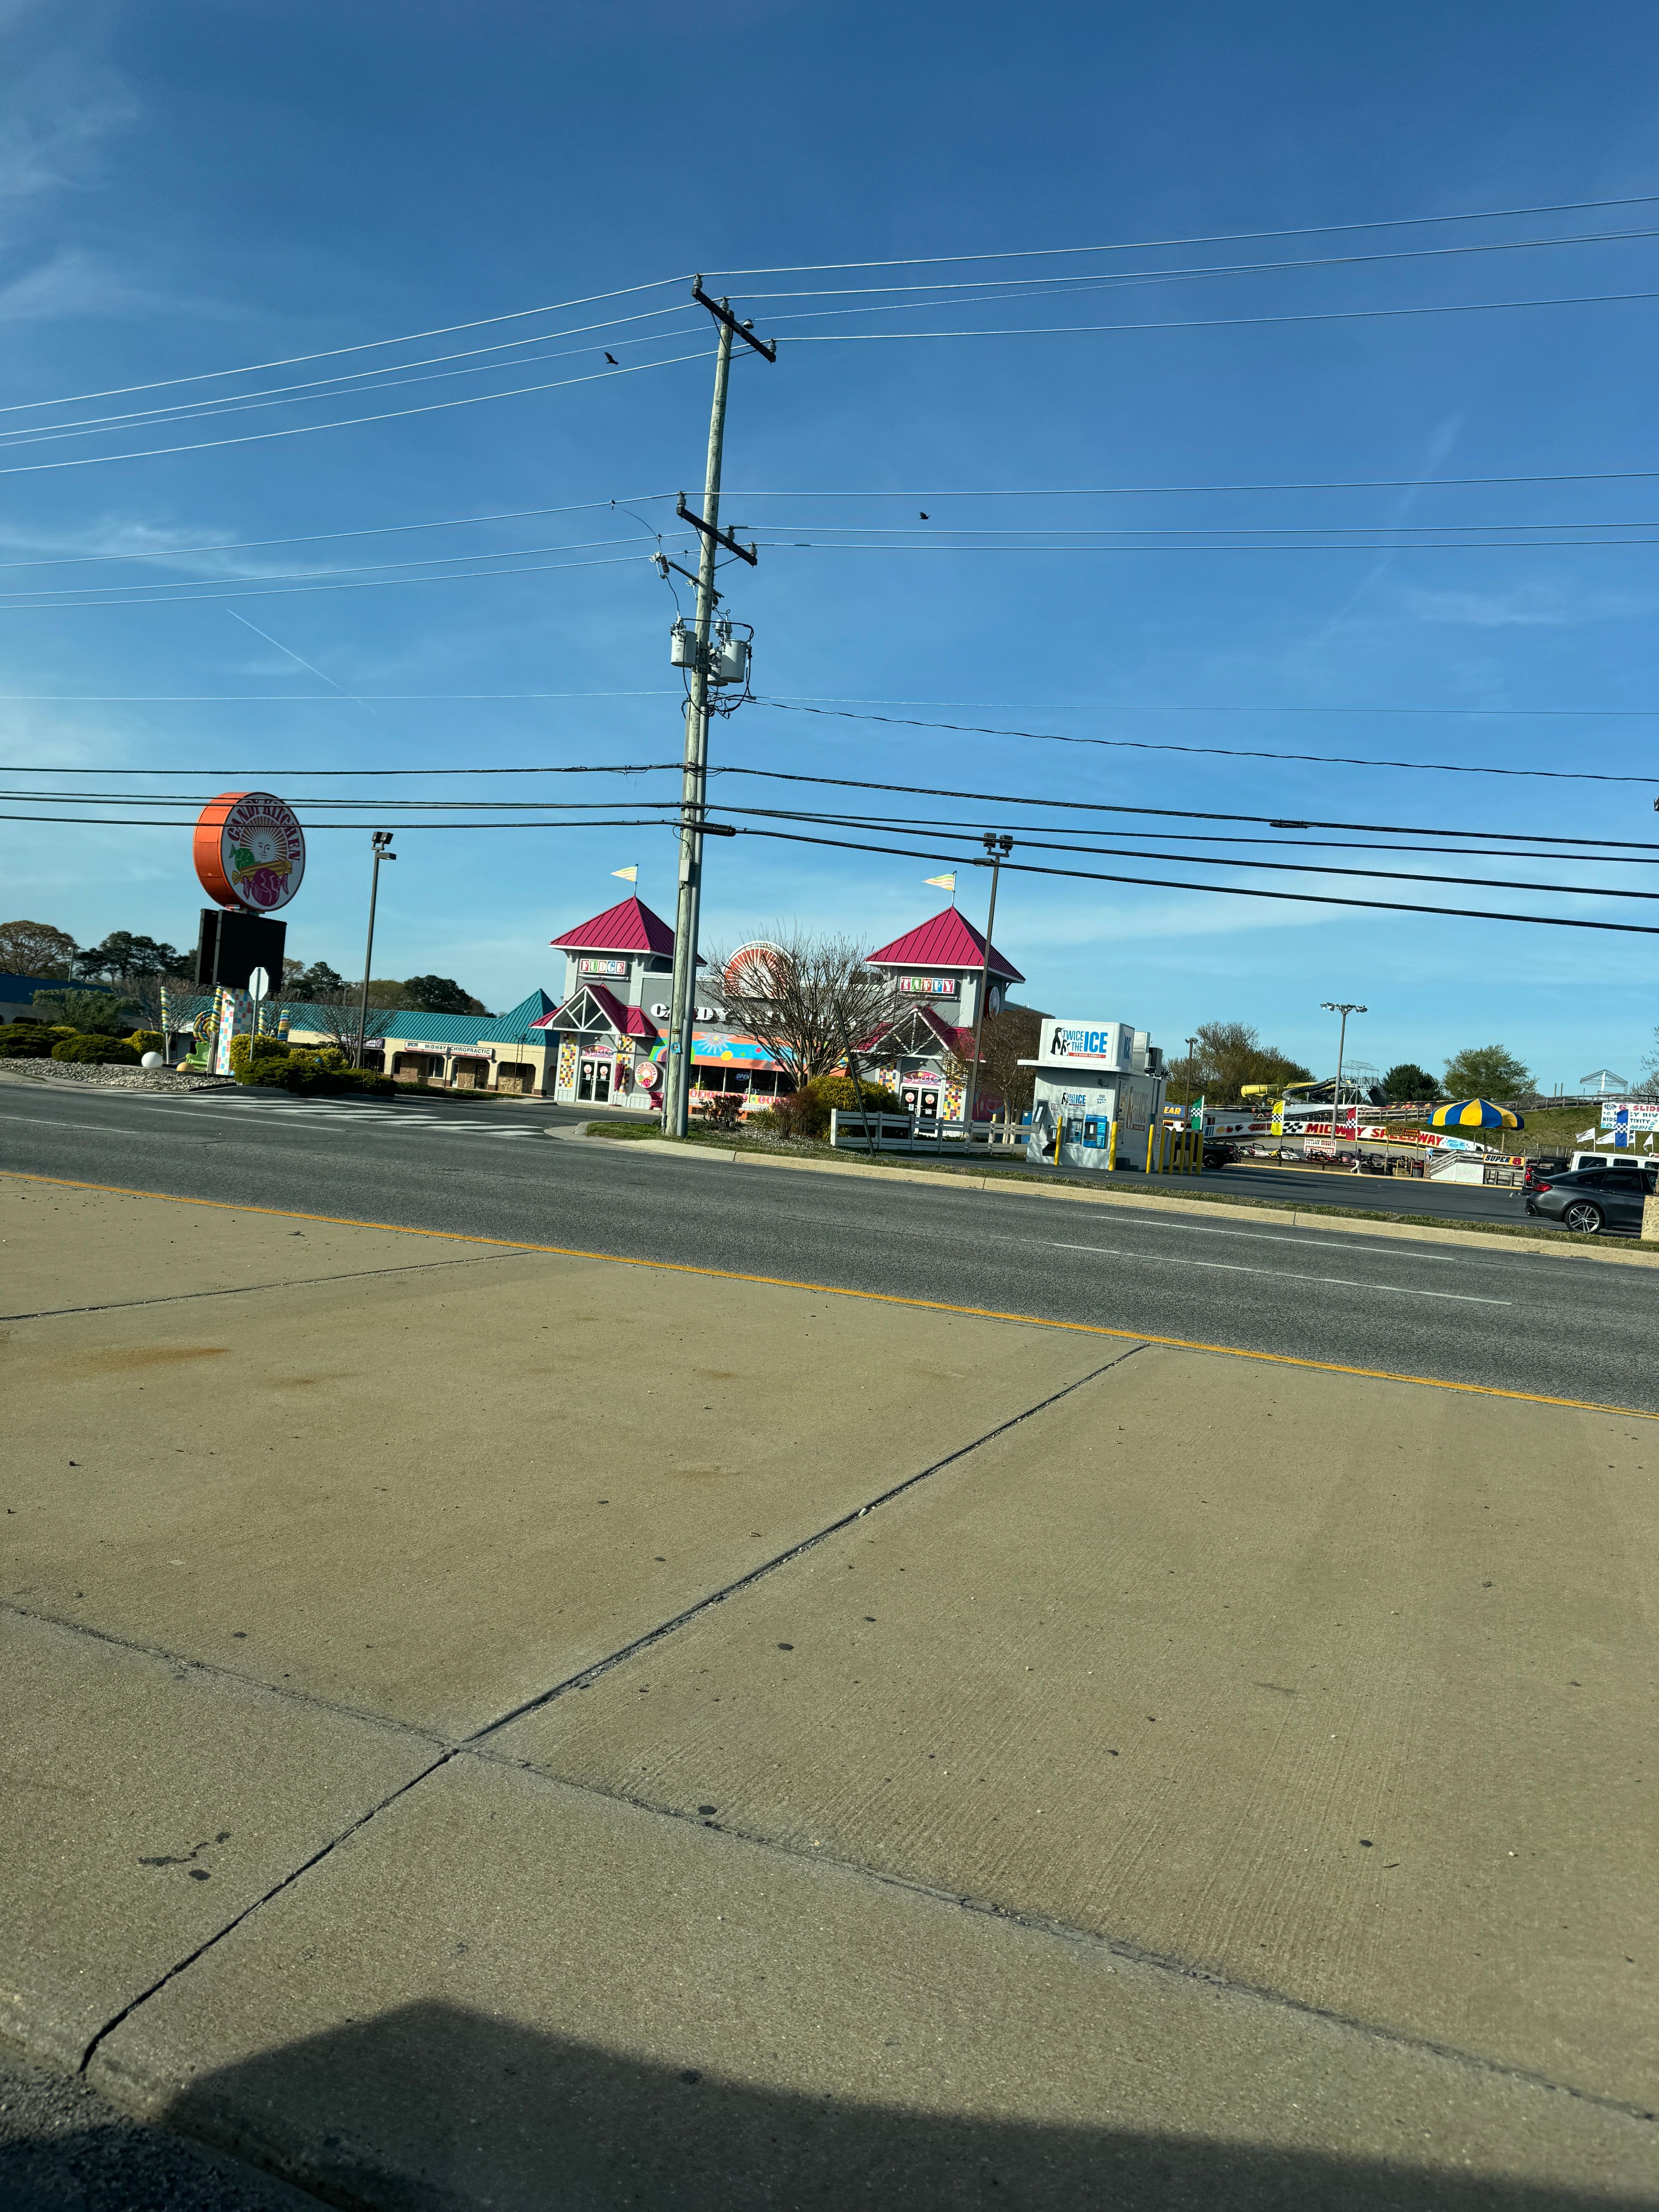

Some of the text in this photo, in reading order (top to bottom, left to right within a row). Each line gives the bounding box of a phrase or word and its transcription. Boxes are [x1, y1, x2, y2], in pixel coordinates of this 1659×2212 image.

[227, 799, 301, 861] CANDY KITCHEN
[581, 960, 624, 973] FUDGE
[901, 977, 953, 993] TAFFY
[651, 1003, 731, 1022] CDY
[1063, 1030, 1084, 1041] TWICE
[1084, 1031, 1108, 1053] ICE
[450, 1046, 490, 1054] CHIROPRACTIC
[1071, 1042, 1084, 1052] THE
[1076, 1094, 1086, 1104] ICE
[1305, 1123, 1367, 1136] MIDWY
[1512, 1157, 1522, 1165] 8
